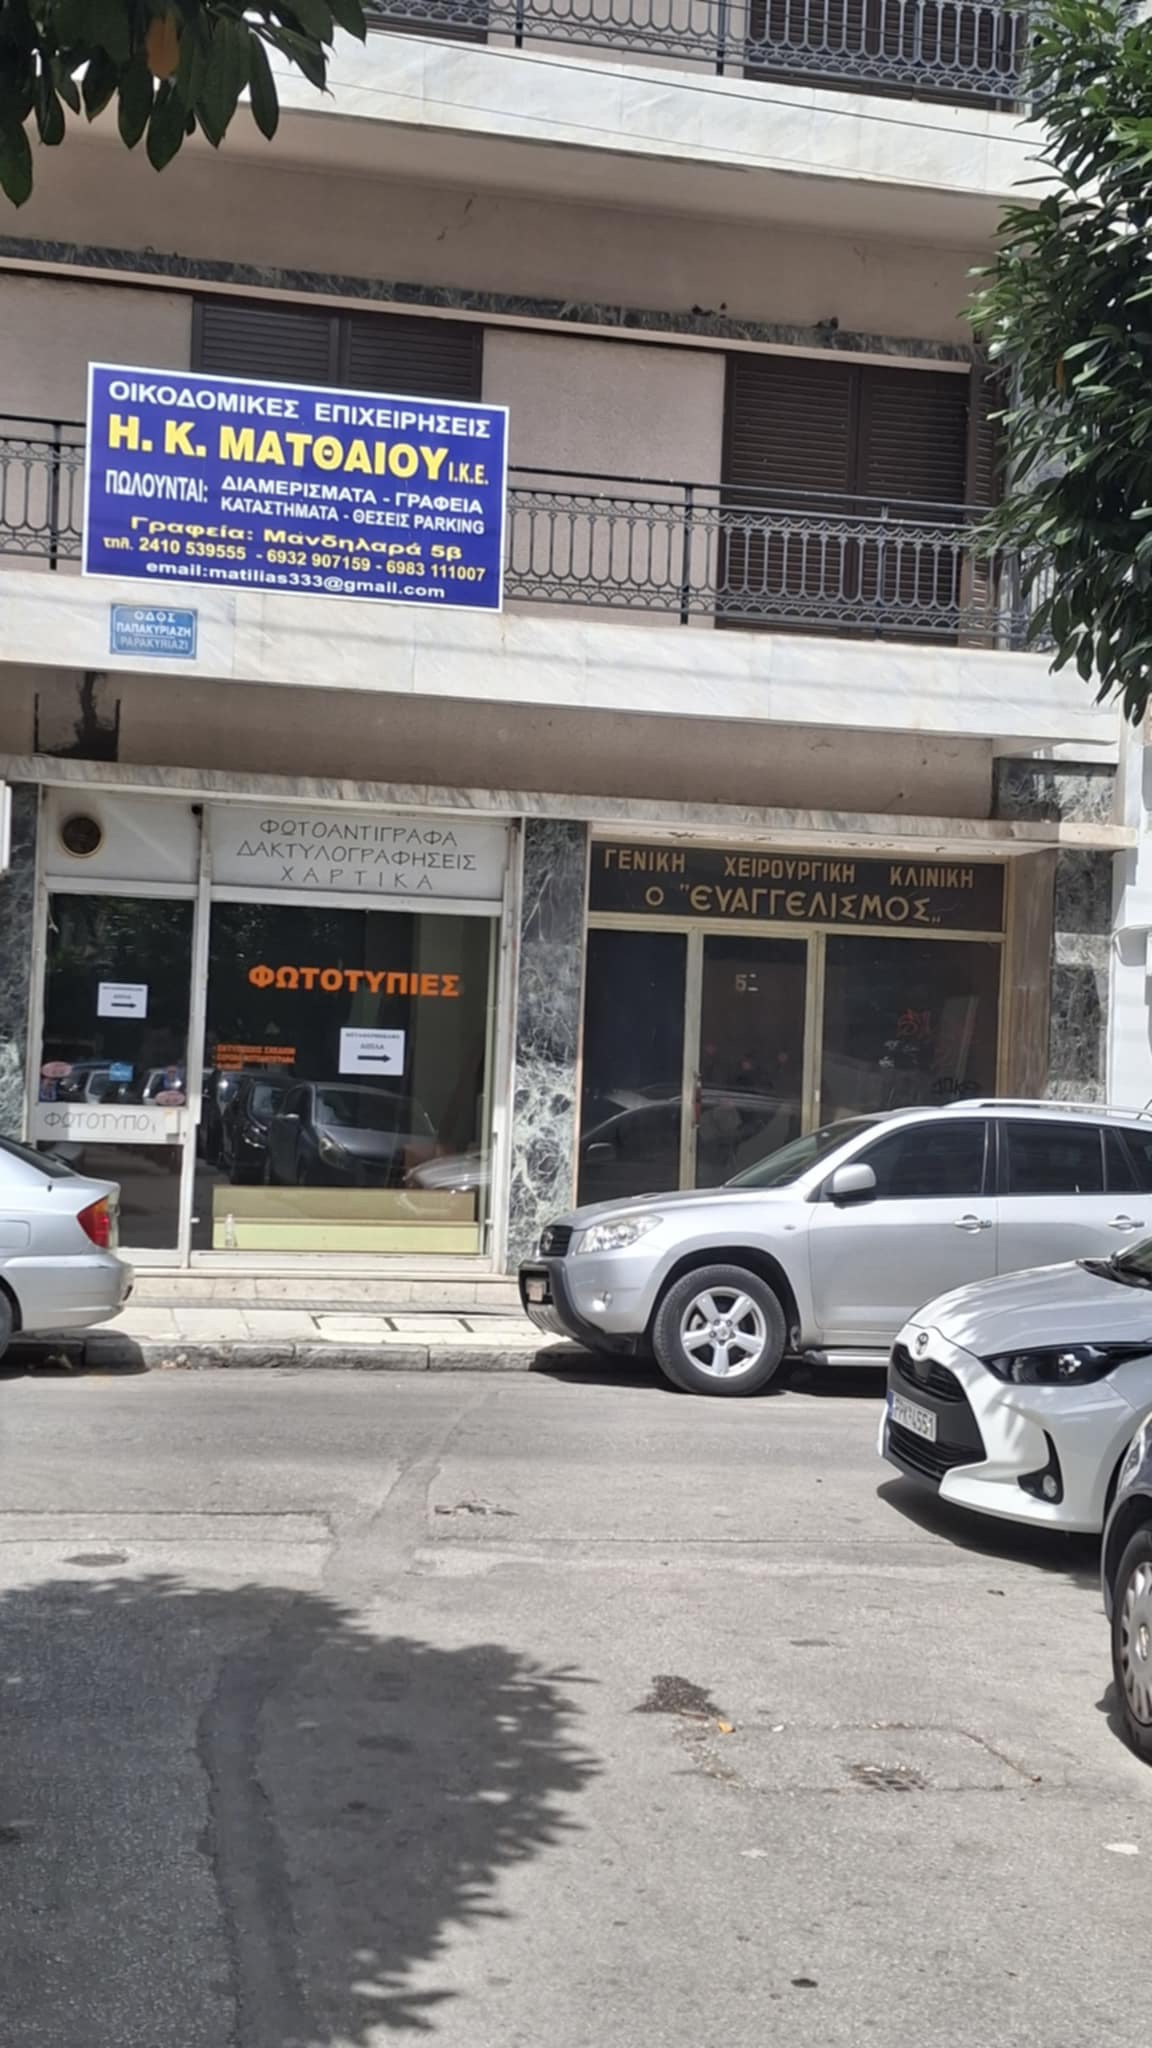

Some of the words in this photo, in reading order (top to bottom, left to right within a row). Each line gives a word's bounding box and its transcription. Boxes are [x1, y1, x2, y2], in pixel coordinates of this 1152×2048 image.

[109, 380, 299, 419] ΟΙΚΟΔΟΜΙΚΕΣ
[314, 402, 491, 439] ΕΠΙΧΕΙΡΗΣΕΙΣ
[108, 413, 153, 452] Η.
[164, 419, 207, 458] Κ.
[219, 424, 449, 481] ΜΑΤΘΑΙΟΥ
[448, 461, 489, 486] Ι.Κ.Ε.
[105, 468, 209, 503] ΠΩΛΟΥΝΤΑΙ:
[221, 475, 377, 505] ΔΙΑΜΕΡΙΣΜΑΤΑ
[395, 491, 484, 515] ΓΡΑΦΕΙΑ
[220, 496, 339, 522] ΚΑΤΑΣΤΗΜΑΤΑ
[352, 508, 410, 529] ΘΕΣΕΙΣ
[413, 514, 485, 536] PARKING
[130, 515, 254, 541] Γραφεία:
[431, 543, 463, 562] 5β
[138, 537, 181, 555] 2410
[185, 541, 246, 560] 539555
[266, 549, 307, 567] 6932
[311, 552, 371, 573] 907159
[386, 559, 425, 577] 6983
[430, 563, 486, 583] 111007
[116, 622, 191, 637] ΠΑΠΑΚΥΡΙΑΖΗ
[134, 611, 176, 623] ΟΔΟΣ
[259, 819, 457, 847] ΦΩΤΟΑΝΤΙΓΡΑΦΑ
[236, 840, 477, 871] ΔΑΚΤΥΛΟΓΡΑΦΗΣΕΙΣ
[604, 848, 686, 873] ΓΕΝΙΚΗ
[724, 856, 856, 884] ΧΕΙΡΟΥΡΓΙΚΗ
[889, 866, 974, 889] ΚΛΙΝΙΚΗ
[281, 866, 433, 890] ΧΑΡΤΙΚΑ
[645, 885, 664, 906] Ο
[248, 964, 460, 997] ΦΩΤΟΤΥΠΙΕΣ
